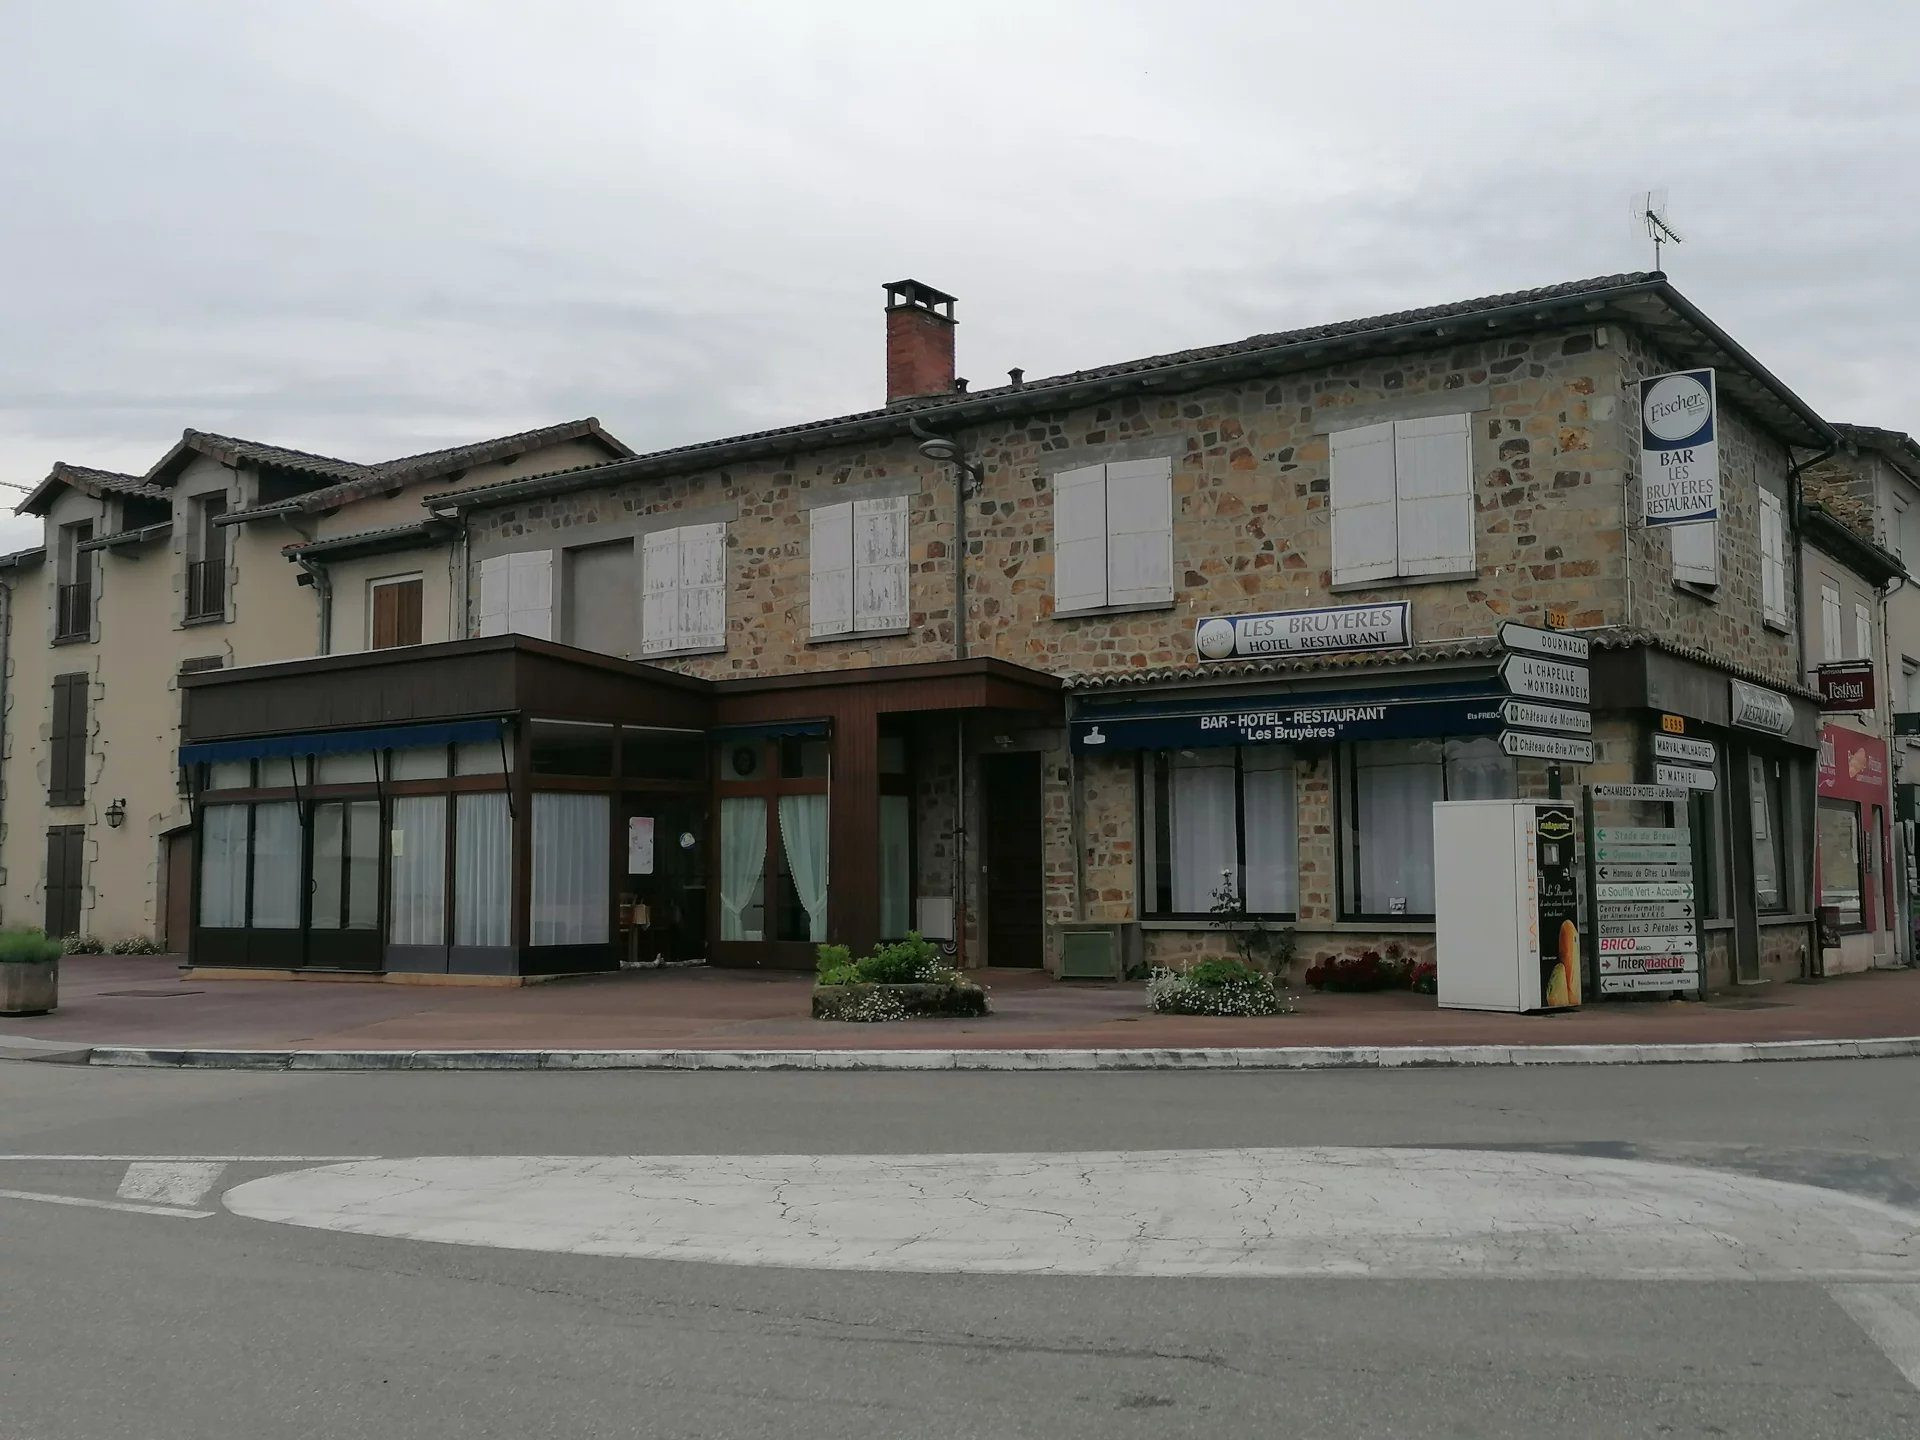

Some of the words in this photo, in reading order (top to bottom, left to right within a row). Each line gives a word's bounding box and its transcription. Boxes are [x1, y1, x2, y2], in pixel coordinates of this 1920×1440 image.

[1651, 393, 1701, 423] Fischer
[1660, 449, 1695, 466] BAR
[1668, 466, 1689, 480] LES
[1646, 479, 1713, 500] BRUYERES
[1647, 494, 1713, 515] RESTAURANT
[1243, 619, 1274, 637] LES
[1289, 609, 1392, 634] BRUYERES
[1249, 639, 1292, 652] HOTEL
[1301, 631, 1388, 648] RESTAURANT
[1541, 635, 1587, 655] DOURNAZAC
[1523, 662, 1533, 675] LA
[1536, 664, 1575, 682] CHAPELLE
[1829, 681, 1863, 698] Festival
[1200, 716, 1228, 729] BAR
[1238, 712, 1283, 727] HOTEL
[1293, 706, 1387, 724] RESTAURANT
[1520, 708, 1548, 723] Château
[1549, 713, 1558, 724] de
[1560, 713, 1590, 727] Montbrun
[1743, 704, 1782, 728] RESTAURANT
[1519, 739, 1545, 752] Château
[1546, 742, 1554, 753] de
[1555, 742, 1567, 755] Brie
[1667, 770, 1697, 783] MATHIEU
[1603, 785, 1632, 796] CHAMBRES
[1635, 869, 1641, 877] de
[1597, 887, 1606, 897] Le
[1608, 886, 1634, 897] Souffle
[1635, 887, 1650, 896] Vert
[1656, 886, 1682, 896] Accueil
[1599, 905, 1620, 913] Centre
[1623, 904, 1631, 912] de
[1600, 924, 1624, 933] Serres
[1628, 924, 1640, 933] Les
[1644, 923, 1649, 933] 3
[1601, 938, 1636, 950] BRICO
[1617, 955, 1685, 970] Intermarché
